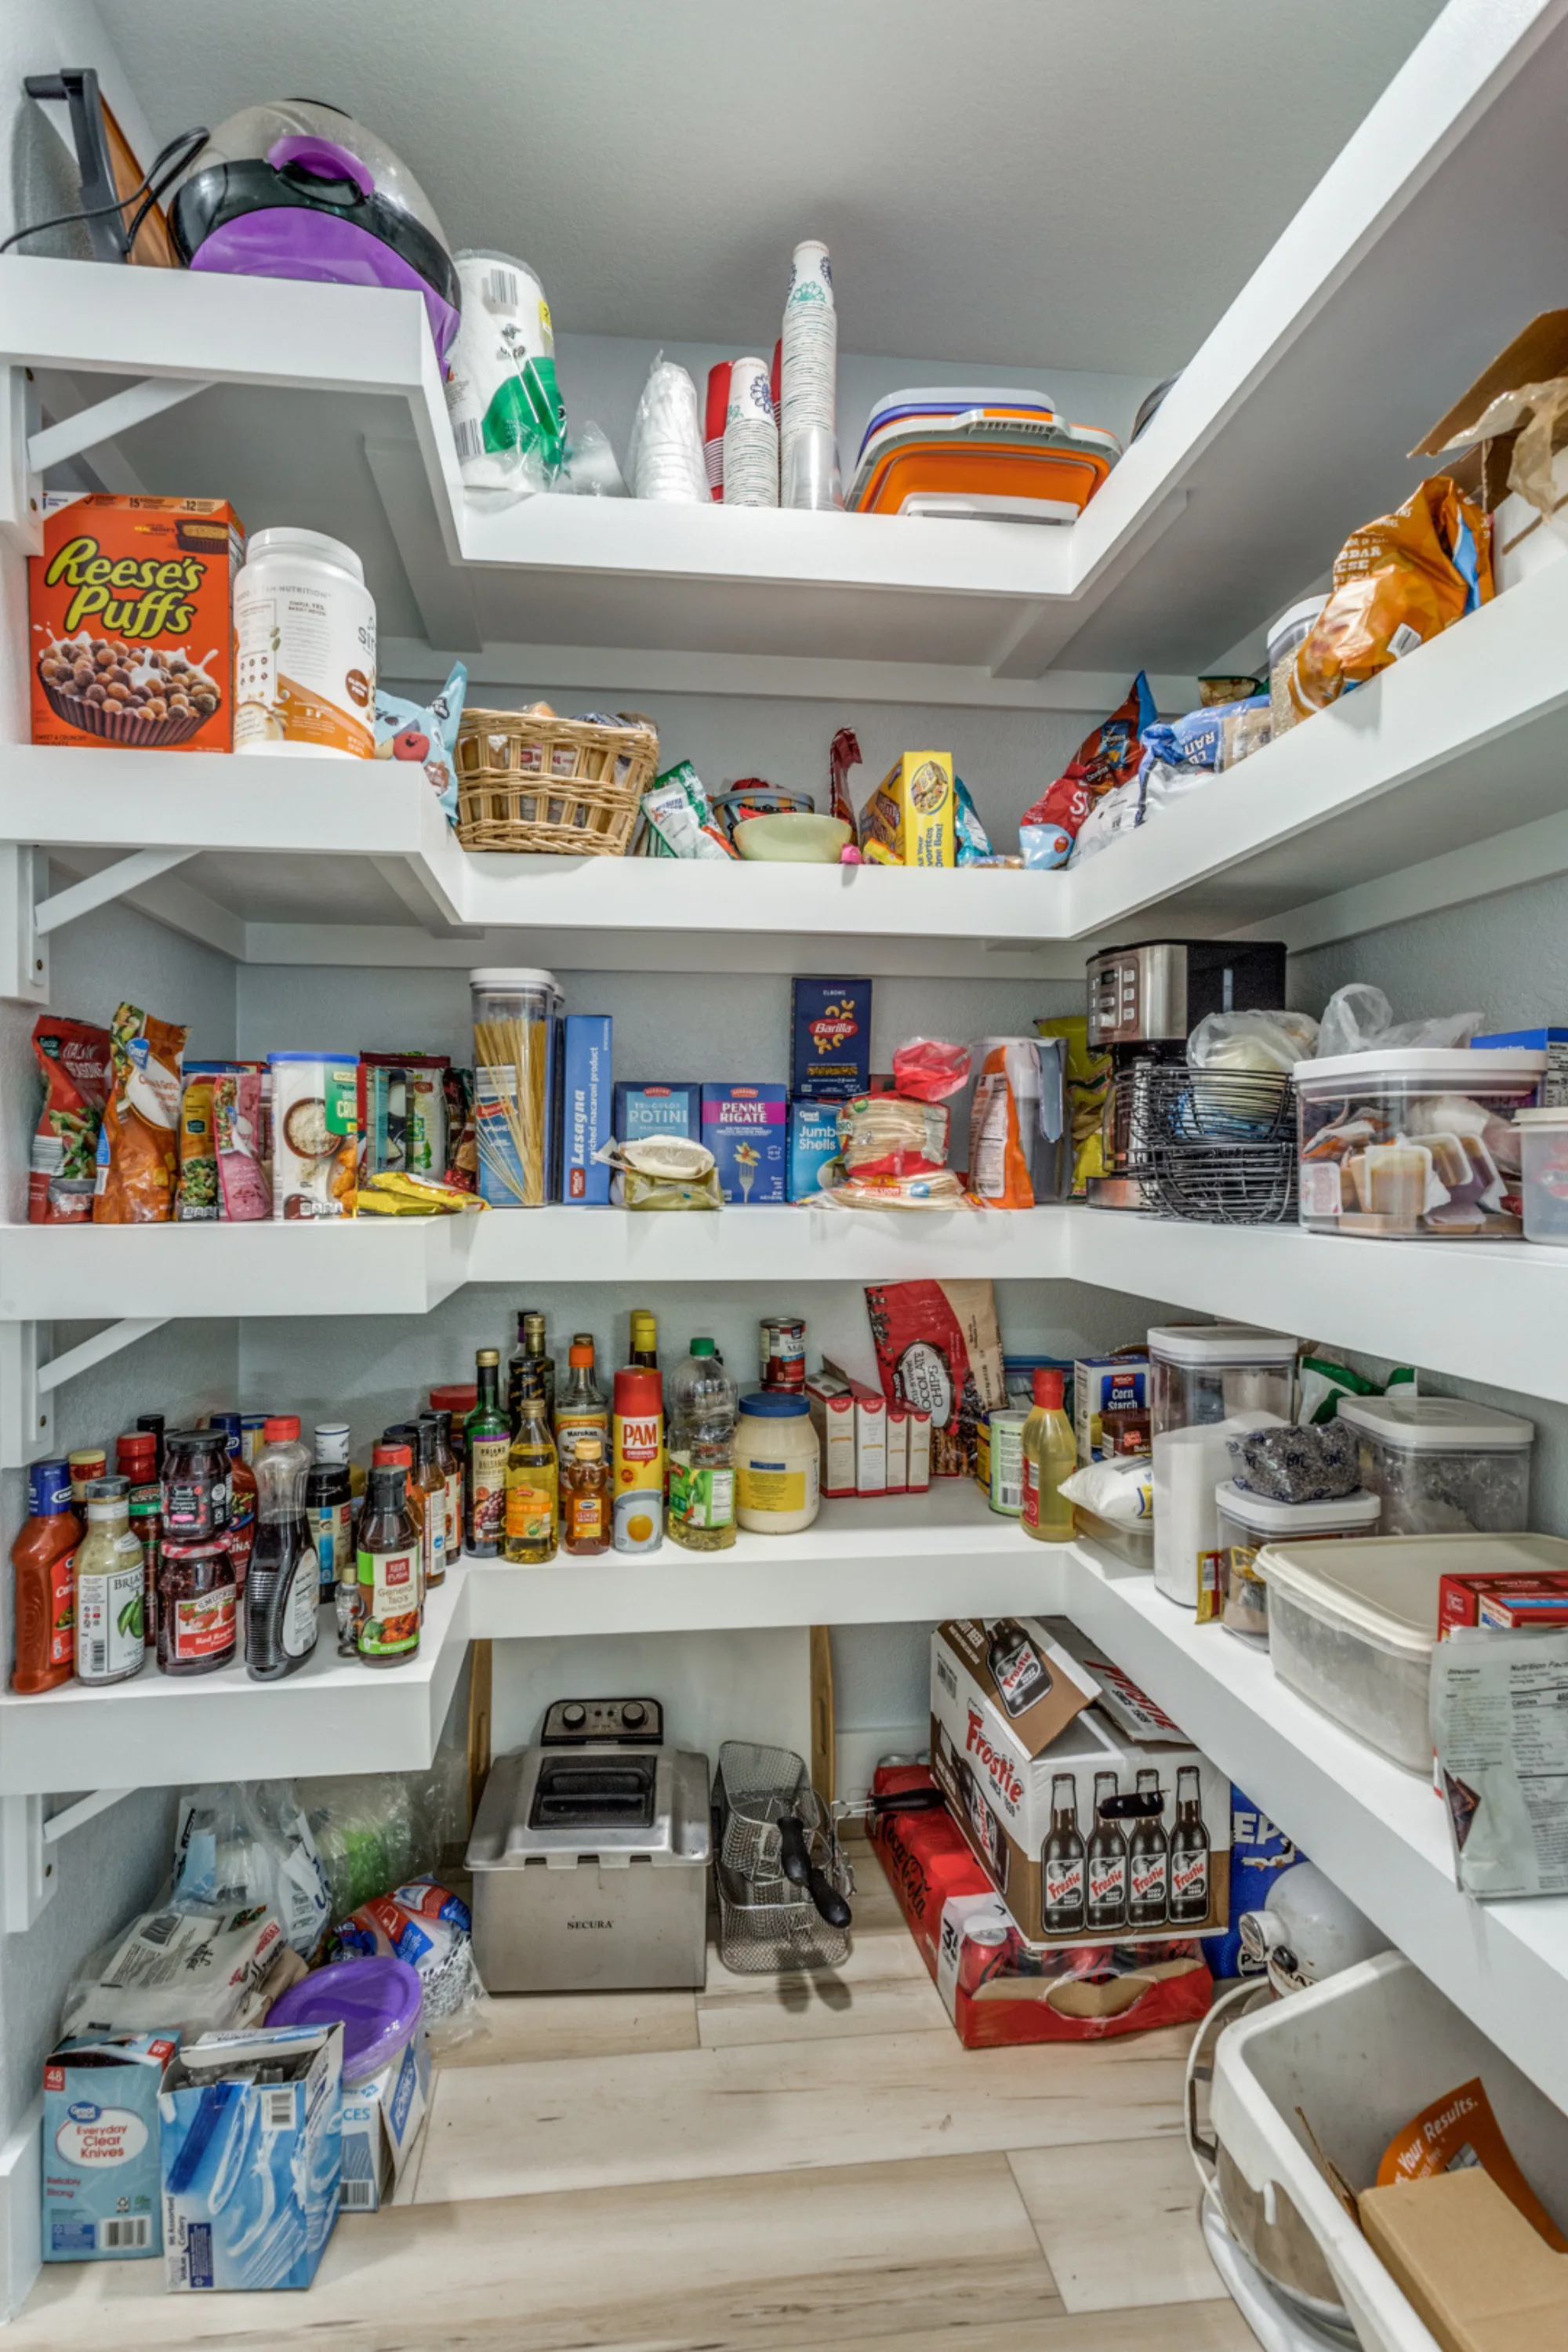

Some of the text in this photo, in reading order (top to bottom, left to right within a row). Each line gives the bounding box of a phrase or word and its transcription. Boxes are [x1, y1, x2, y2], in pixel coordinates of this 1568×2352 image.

[45, 536, 208, 591] Reese's
[64, 584, 196, 637] Puffs
[815, 1023, 855, 1033] Barilla
[590, 1047, 599, 1083] product
[721, 1102, 766, 1112] PENNE
[629, 1110, 688, 1123] ROTINI
[720, 1112, 768, 1123] RIGATE
[571, 1089, 587, 1166] Lasagna
[799, 1126, 836, 1138] Jumb
[799, 1138, 837, 1151] Shells
[913, 1350, 931, 1410] OCOLATE
[927, 1365, 943, 1407] CHIPS
[1112, 1388, 1134, 1399] Corn
[1107, 1399, 1138, 1410] Starch
[623, 1423, 657, 1446] PAM
[114, 1570, 144, 1591] BRIAN
[378, 1584, 413, 1597] General
[195, 1635, 212, 1646] Red
[1001, 1651, 1032, 1689] Frostie
[1510, 1662, 1547, 1671] Nutrition
[966, 1709, 1023, 1803] Frostie
[1091, 1870, 1123, 1897] Frostie
[1132, 1867, 1164, 1894] Frostie
[1173, 1863, 1204, 1890] Frostie
[1047, 1871, 1080, 1900] Frostie
[566, 1919, 614, 1930] SECURA
[47, 2069, 64, 2083] 48
[70, 2105, 96, 2114] Great
[343, 2107, 371, 2122] CES
[1423, 2097, 1479, 2143] Results.
[76, 2125, 129, 2136] Everyday
[83, 2136, 121, 2147] Clear
[81, 2147, 125, 2158] Knives
[1397, 2138, 1425, 2175] Your
[46, 2176, 81, 2186] Reliably
[46, 2188, 74, 2198] Strong
[177, 2215, 187, 2245] Cutlery
